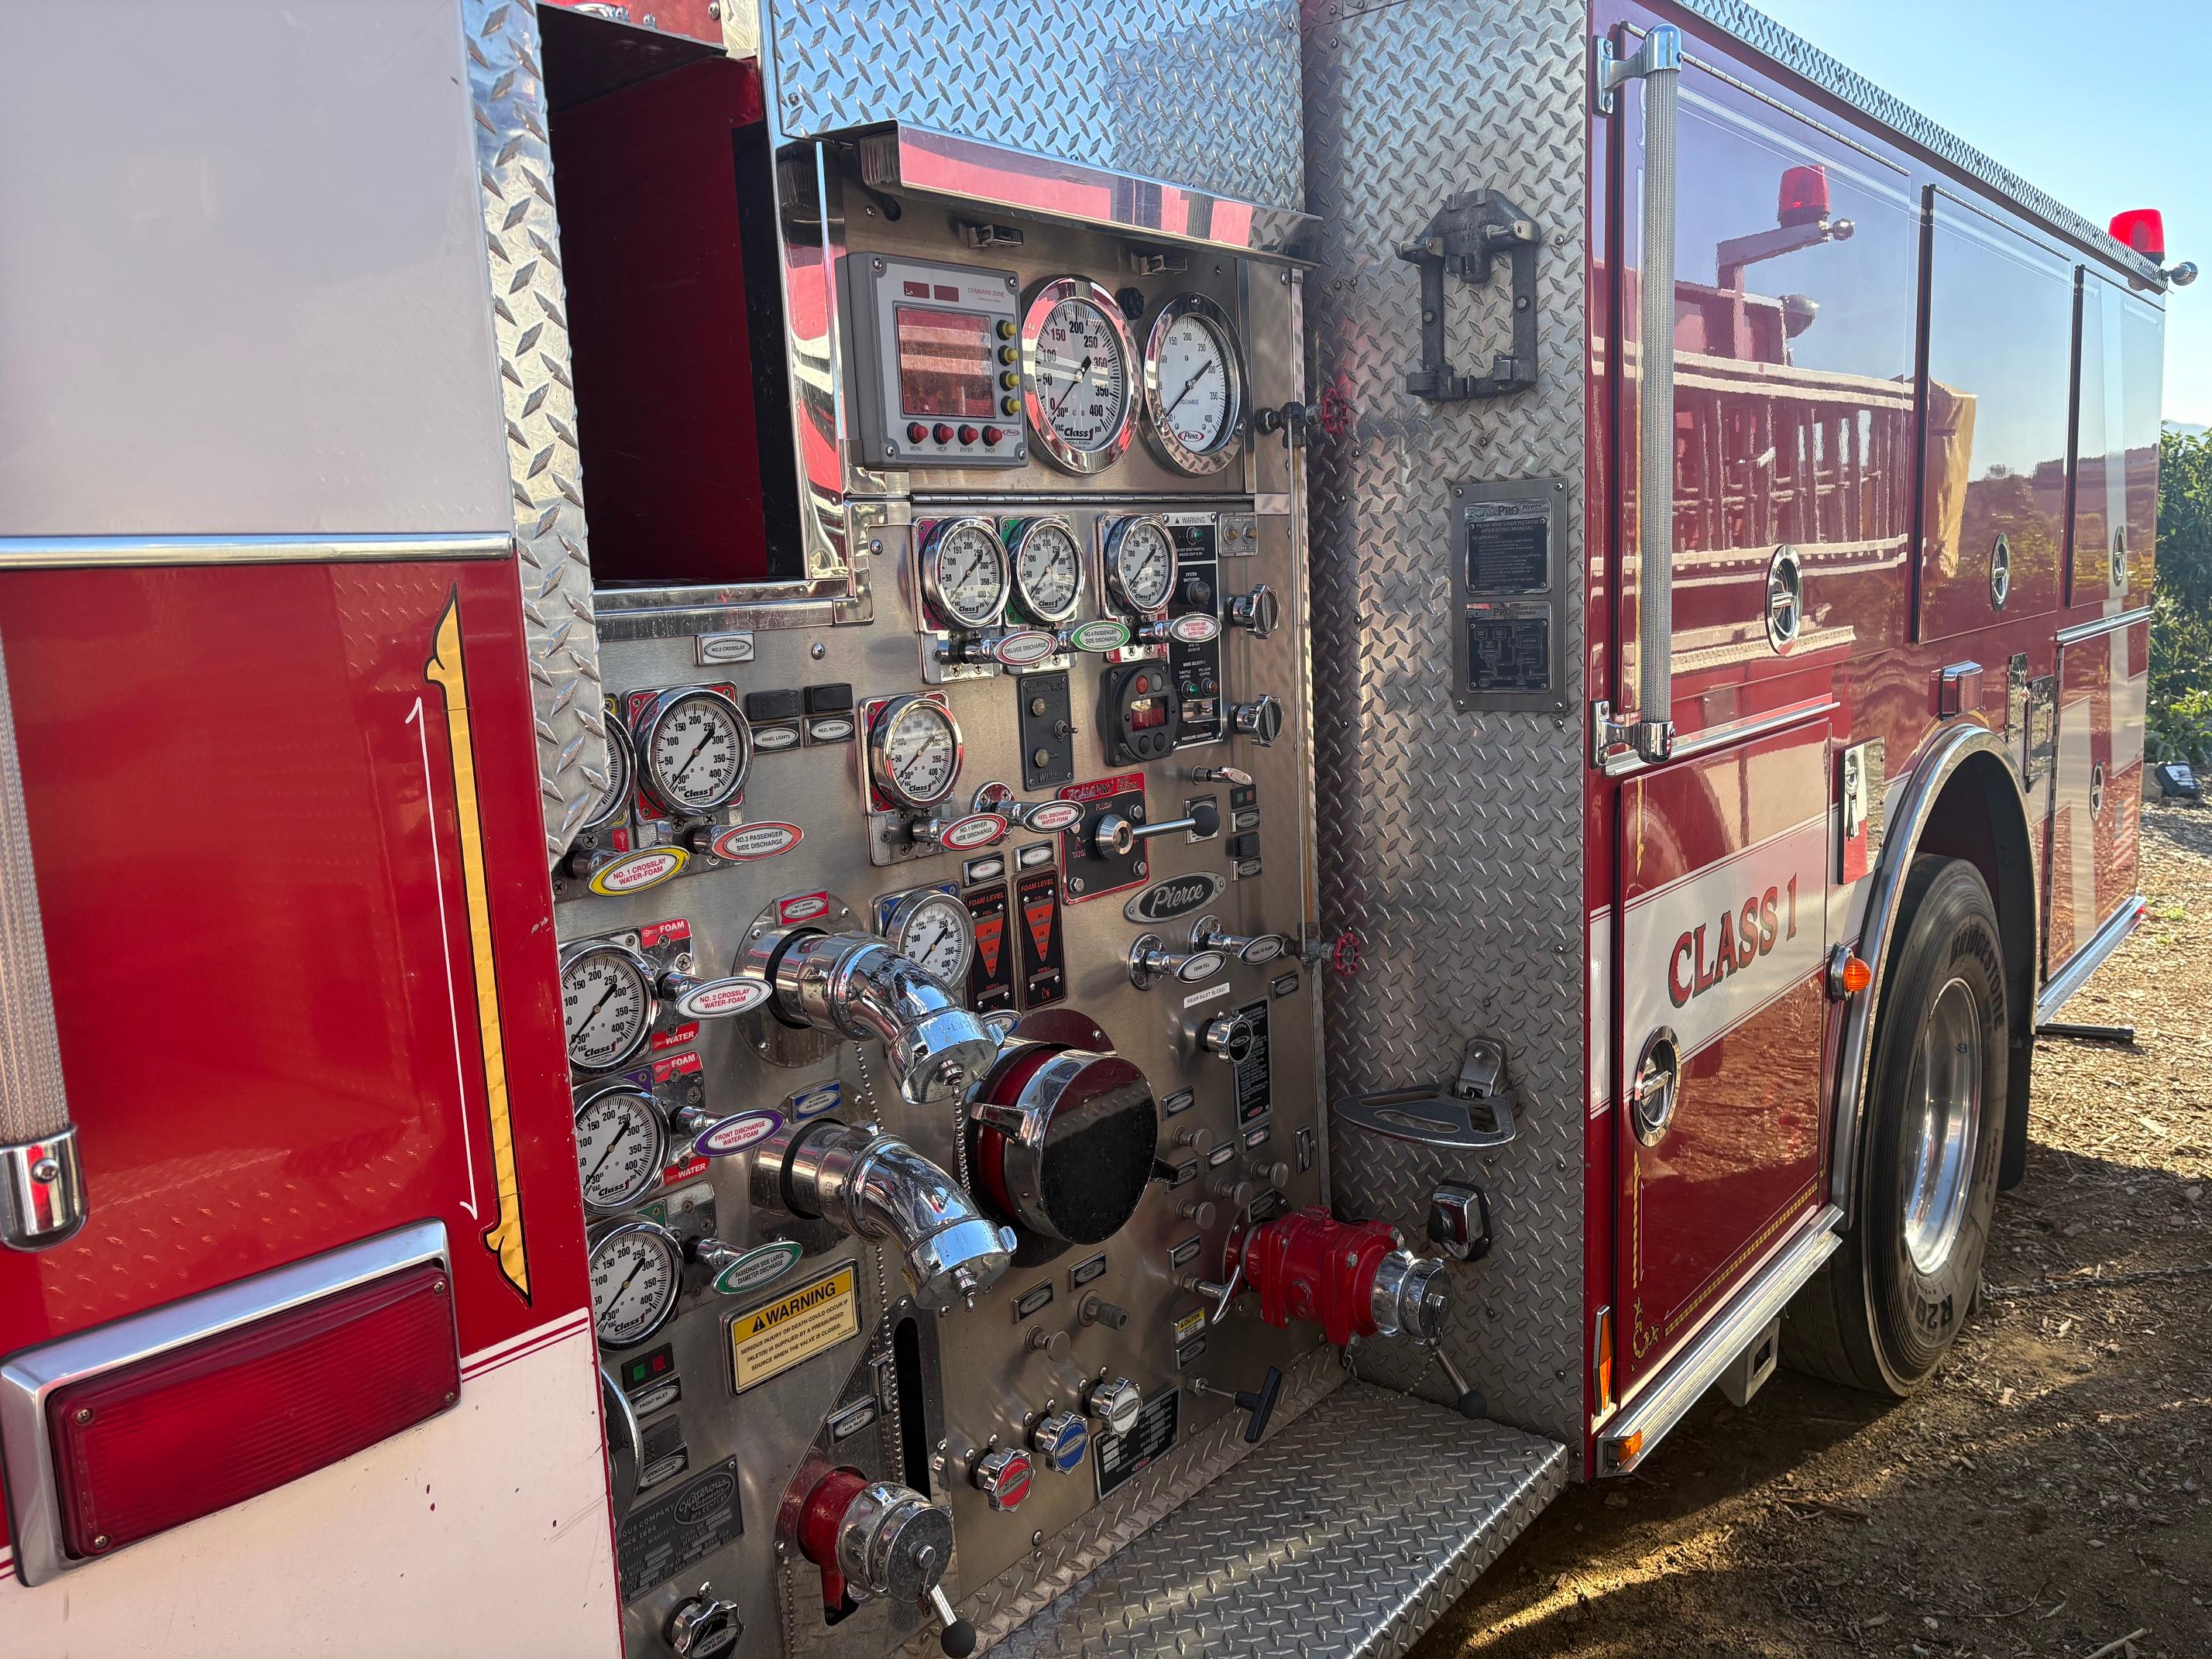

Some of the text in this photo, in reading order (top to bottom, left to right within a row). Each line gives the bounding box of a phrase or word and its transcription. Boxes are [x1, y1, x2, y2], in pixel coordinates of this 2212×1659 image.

[968, 287, 991, 296] COMMAND
[1070, 321, 1084, 335] 200
[1051, 328, 1066, 342] 150
[1169, 336, 1177, 345] 150
[1084, 335, 1098, 349] 250
[1090, 404, 1103, 417] 400
[1184, 431, 1199, 440] Pierce
[1022, 642, 1046, 651] DISCHARGE
[689, 716, 701, 724] 200
[675, 723, 686, 732] 150
[666, 737, 678, 746] 100
[712, 736, 724, 745] 300
[665, 756, 673, 765] 50
[713, 754, 725, 763] 350
[709, 768, 721, 778] 400
[1049, 809, 1071, 818] DISCHARGE
[1042, 816, 1068, 825] WATER-FOAM
[750, 831, 783, 841] PASSENGER
[967, 827, 993, 838] DISCHARGE
[751, 839, 782, 849] DISCHARGE
[613, 871, 625, 880] NO.
[632, 857, 666, 874] CROSSLAY
[619, 866, 663, 885] WATER-FOAM
[1021, 878, 1053, 892] FOAM LEVEL
[969, 892, 1005, 907] FOAM LEVEL
[1151, 884, 1204, 917] Pierce
[660, 921, 685, 933] FOAM
[1668, 872, 1797, 1008] CLASS 1
[589, 970, 601, 981] 200
[604, 975, 617, 986] 250
[1947, 929, 2004, 1032] BRIDGESTONE
[574, 979, 586, 991] 150
[613, 987, 627, 998] 300
[717, 988, 750, 1000] CROSSLAY
[565, 995, 578, 1006] 100
[704, 996, 746, 1009] WATER-FOAM
[615, 1006, 628, 1017] 350
[611, 1022, 623, 1032] 400
[665, 1031, 694, 1044] WATER
[671, 1055, 696, 1067] FOAM
[602, 1110, 615, 1121] 200
[618, 1114, 630, 1125] 250
[587, 1121, 599, 1132] 150
[627, 1125, 640, 1136] 300
[715, 1121, 765, 1142] FRONT DISCHARGE
[579, 1137, 592, 1148] 100
[722, 1130, 759, 1146] WATER-FOAM
[629, 1143, 642, 1155] 350
[625, 1160, 637, 1171] 400
[678, 1163, 706, 1178] WATER
[617, 1247, 630, 1259] 200
[633, 1249, 645, 1260] 250
[603, 1259, 615, 1269] 150
[642, 1259, 654, 1271] 300
[736, 1252, 785, 1277] PASSENGER SIDE LARGE
[737, 1259, 783, 1284] DIAMETER DISCHARGE
[595, 1275, 607, 1286] 100
[644, 1278, 657, 1290] 350
[641, 1293, 653, 1305] 400
[765, 1282, 836, 1325] WARNING
[1183, 1314, 1200, 1326] CAUTION
[740, 1341, 763, 1355] SERIOUS
[764, 1331, 782, 1344] INJURY
[792, 1320, 808, 1331] DEATH
[809, 1311, 825, 1322] COULD
[826, 1304, 843, 1313] OCCUR
[747, 1348, 768, 1362] INLET(S)
[775, 1334, 799, 1349] SUPPLIED
[812, 1311, 844, 1331] PRESSURIZED
[751, 1358, 772, 1371] SOURCE
[774, 1350, 788, 1359] WHEN
[789, 1344, 799, 1352] THE
[800, 1337, 815, 1347] VALVE
[822, 1324, 842, 1337] CLOSED.
[639, 1393, 668, 1410] FRONT INLET
[646, 1459, 676, 1479] OPEN/CLOSED
[678, 1479, 725, 1513] Waterous
[639, 1504, 675, 1527] COMPANY
